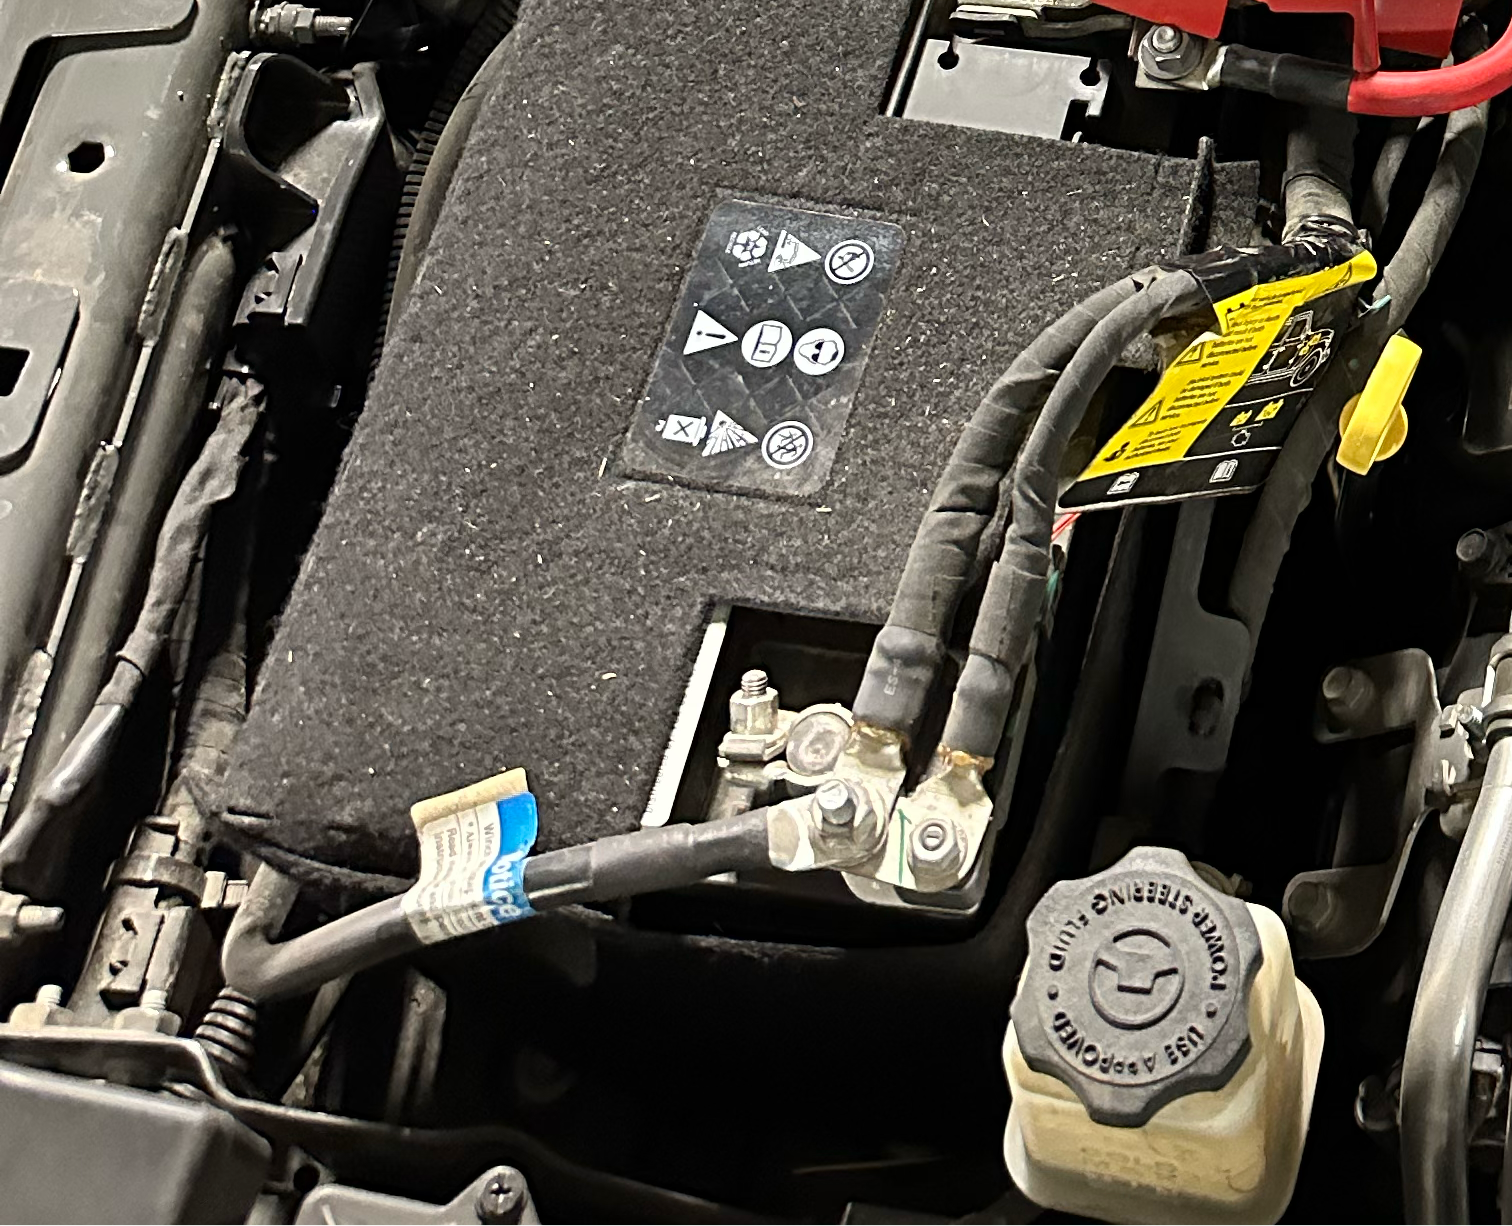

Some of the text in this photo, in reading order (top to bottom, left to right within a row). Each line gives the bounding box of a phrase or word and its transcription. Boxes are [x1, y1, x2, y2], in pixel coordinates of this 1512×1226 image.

[1049, 881, 1228, 991] POWER STEERING FLUID
[1053, 1011, 1205, 1075] USE APPROVED
